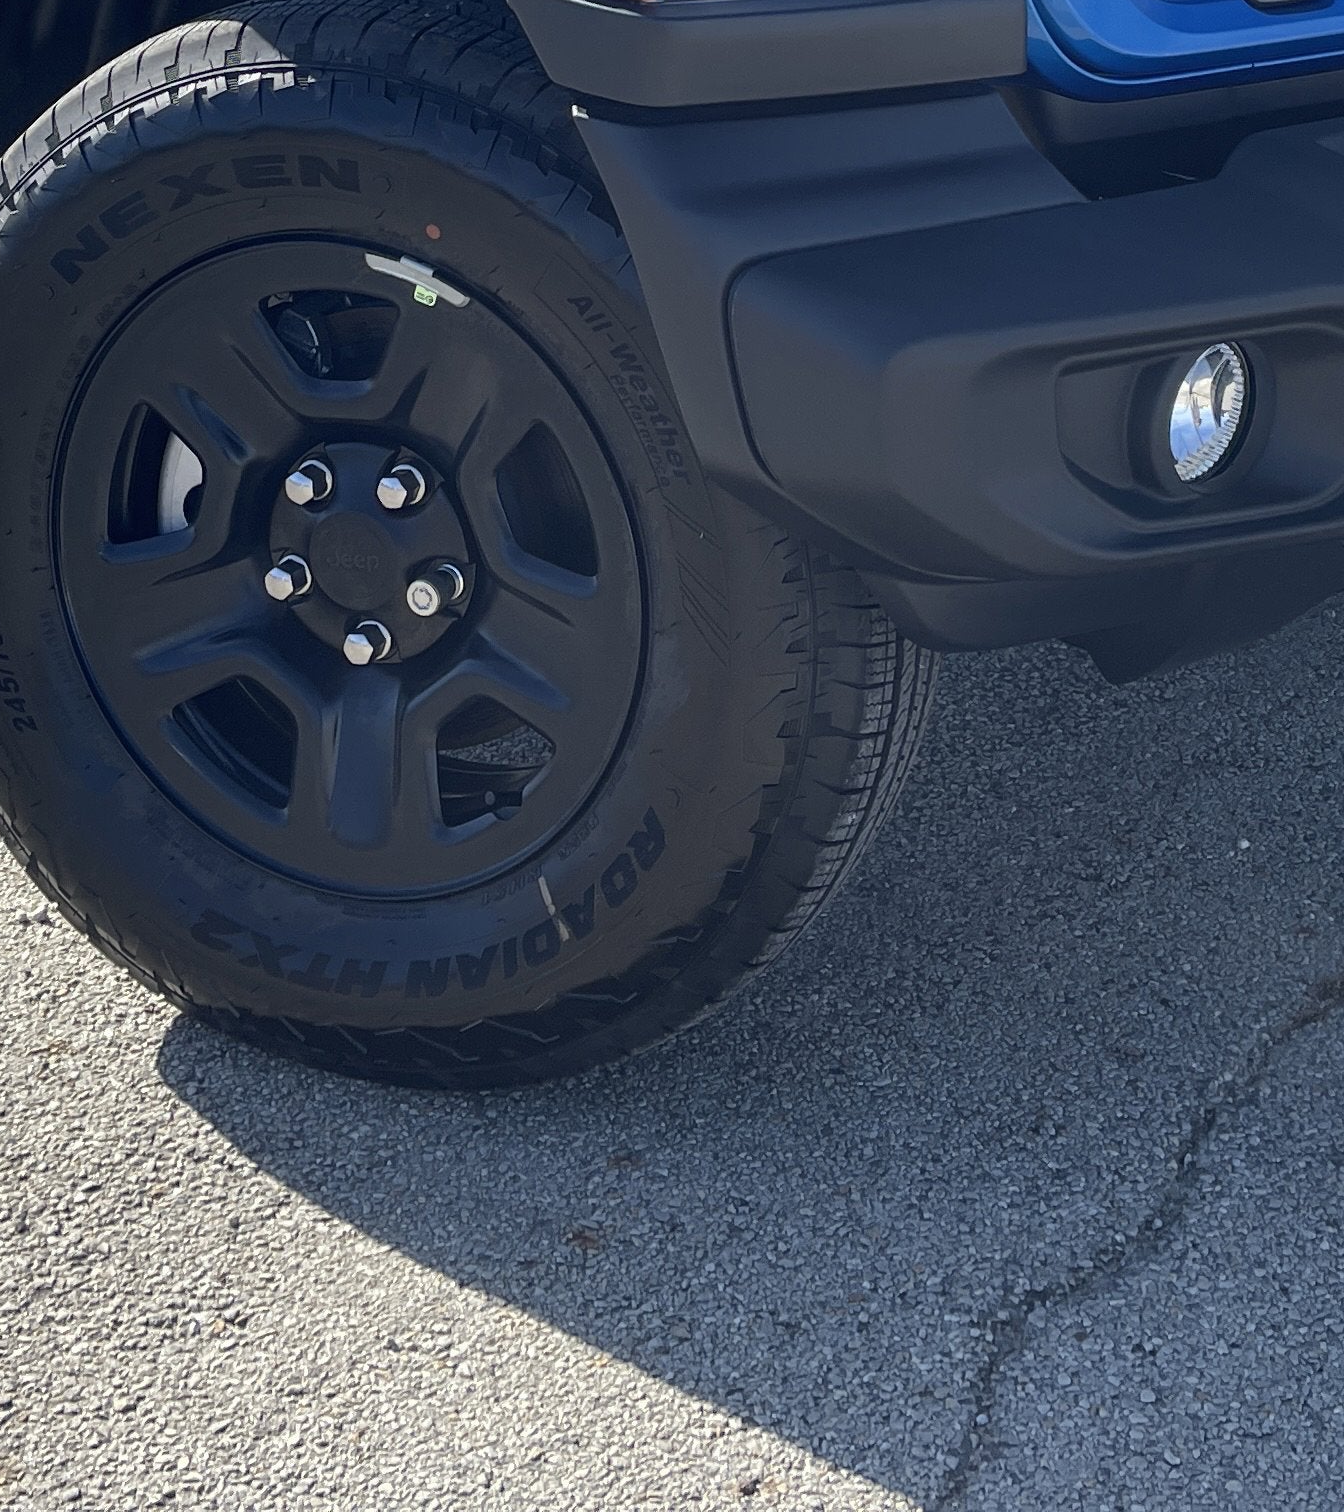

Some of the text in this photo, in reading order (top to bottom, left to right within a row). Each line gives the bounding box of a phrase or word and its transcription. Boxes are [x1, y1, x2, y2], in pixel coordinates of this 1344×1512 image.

[49, 153, 362, 285] NEXEN
[565, 295, 693, 486] All-Weather
[189, 804, 668, 999] ROADIAN HTX2
